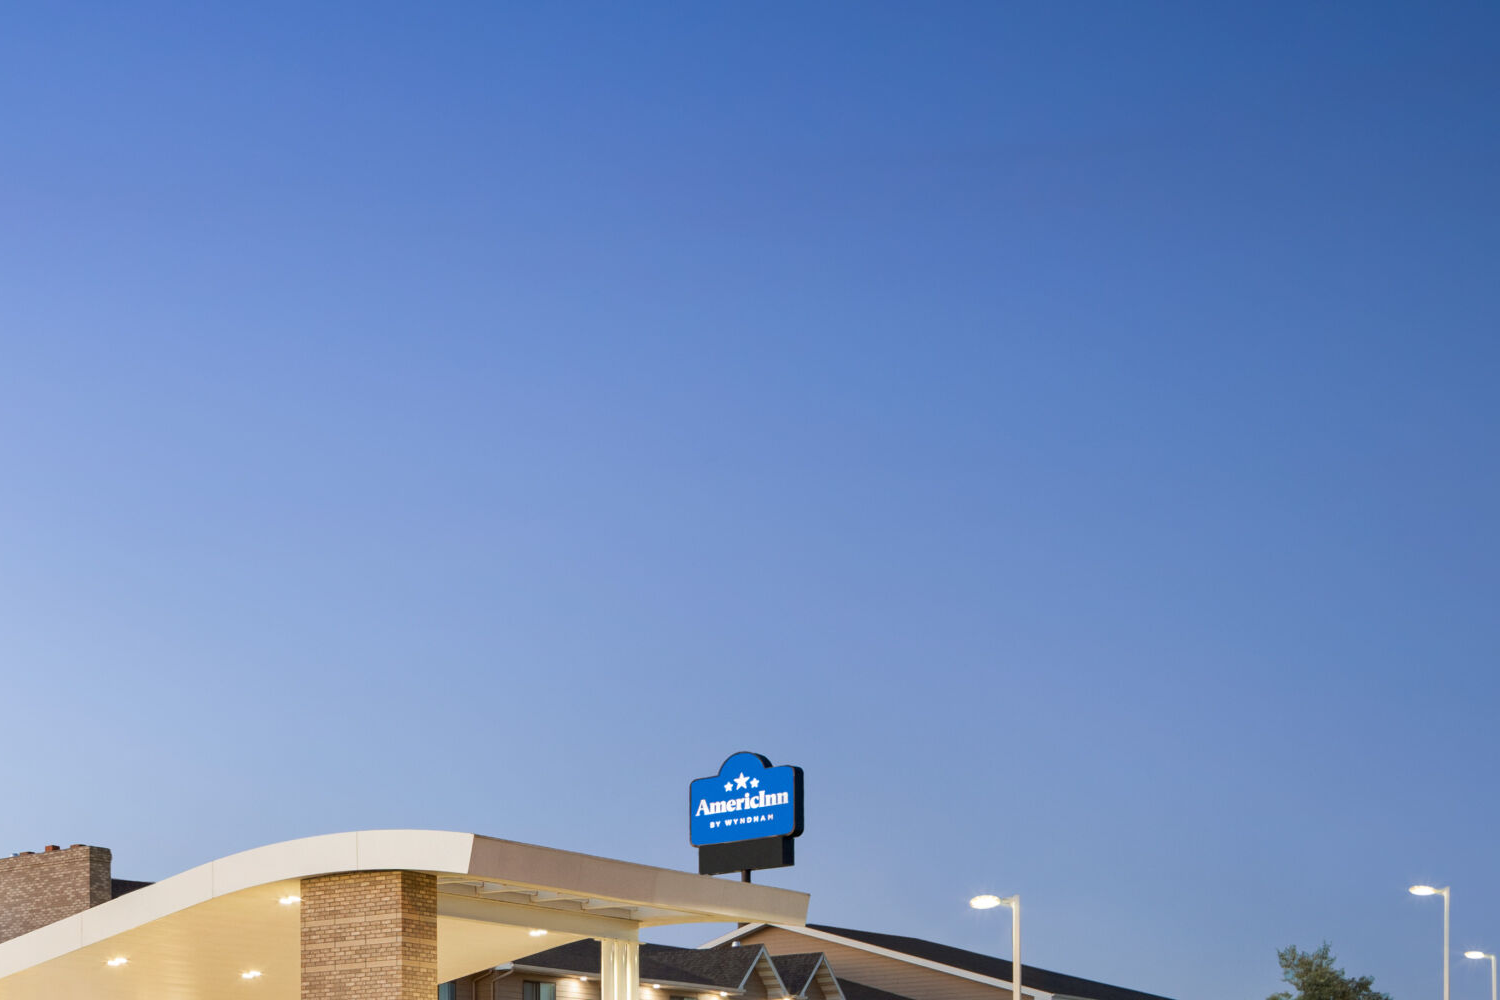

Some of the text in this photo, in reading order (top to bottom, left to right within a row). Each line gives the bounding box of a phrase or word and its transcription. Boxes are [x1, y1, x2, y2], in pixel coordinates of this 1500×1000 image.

[695, 790, 788, 816] AmericInn
[710, 814, 774, 829] BY WYNDHAM
